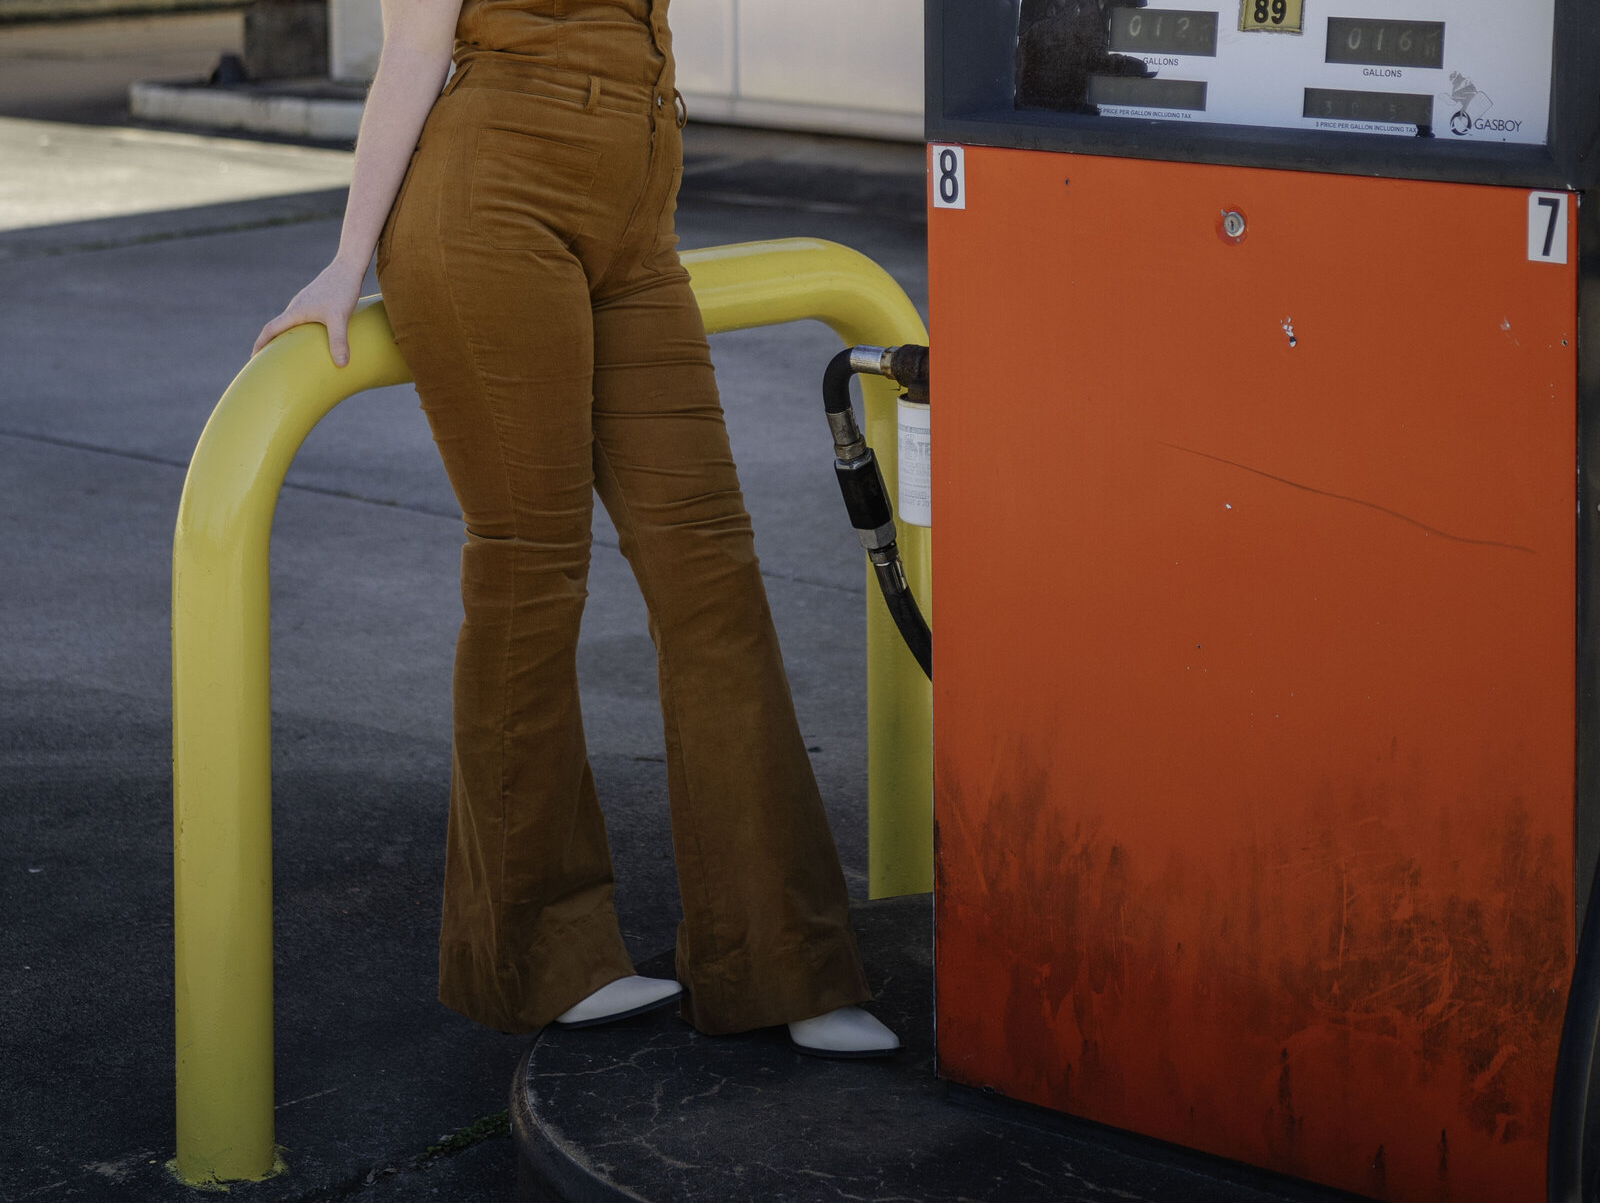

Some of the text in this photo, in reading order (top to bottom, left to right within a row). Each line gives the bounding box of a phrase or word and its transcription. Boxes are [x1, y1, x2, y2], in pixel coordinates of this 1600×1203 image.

[1143, 57, 1179, 66] GALLONS
[1363, 68, 1402, 77] GALLONS
[1474, 118, 1523, 132] GASBOY
[940, 149, 959, 204] 8
[1538, 197, 1561, 257] 7
